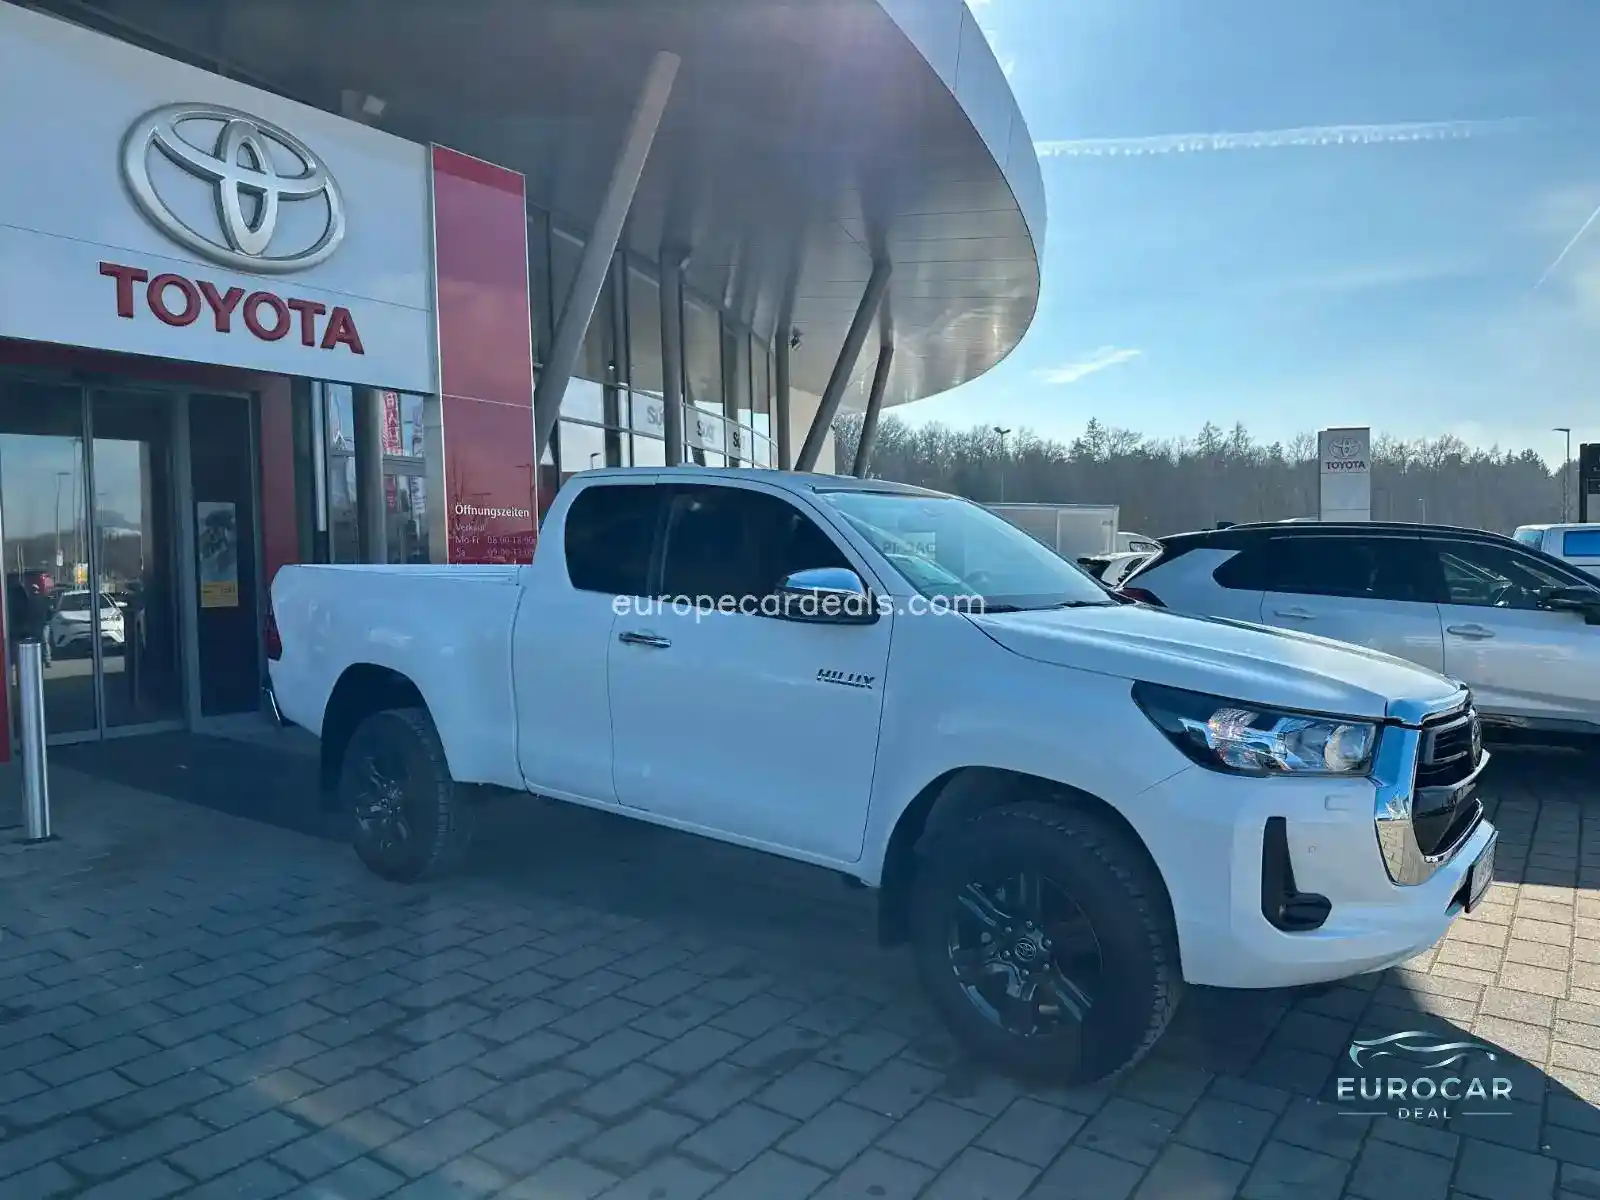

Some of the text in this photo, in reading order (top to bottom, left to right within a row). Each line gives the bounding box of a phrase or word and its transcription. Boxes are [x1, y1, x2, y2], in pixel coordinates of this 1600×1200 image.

[99, 260, 365, 356] TOYOTA
[1325, 460, 1367, 471] TOYOTA
[455, 502, 530, 519] Öffnungszeiten
[816, 667, 875, 690] HILUX
